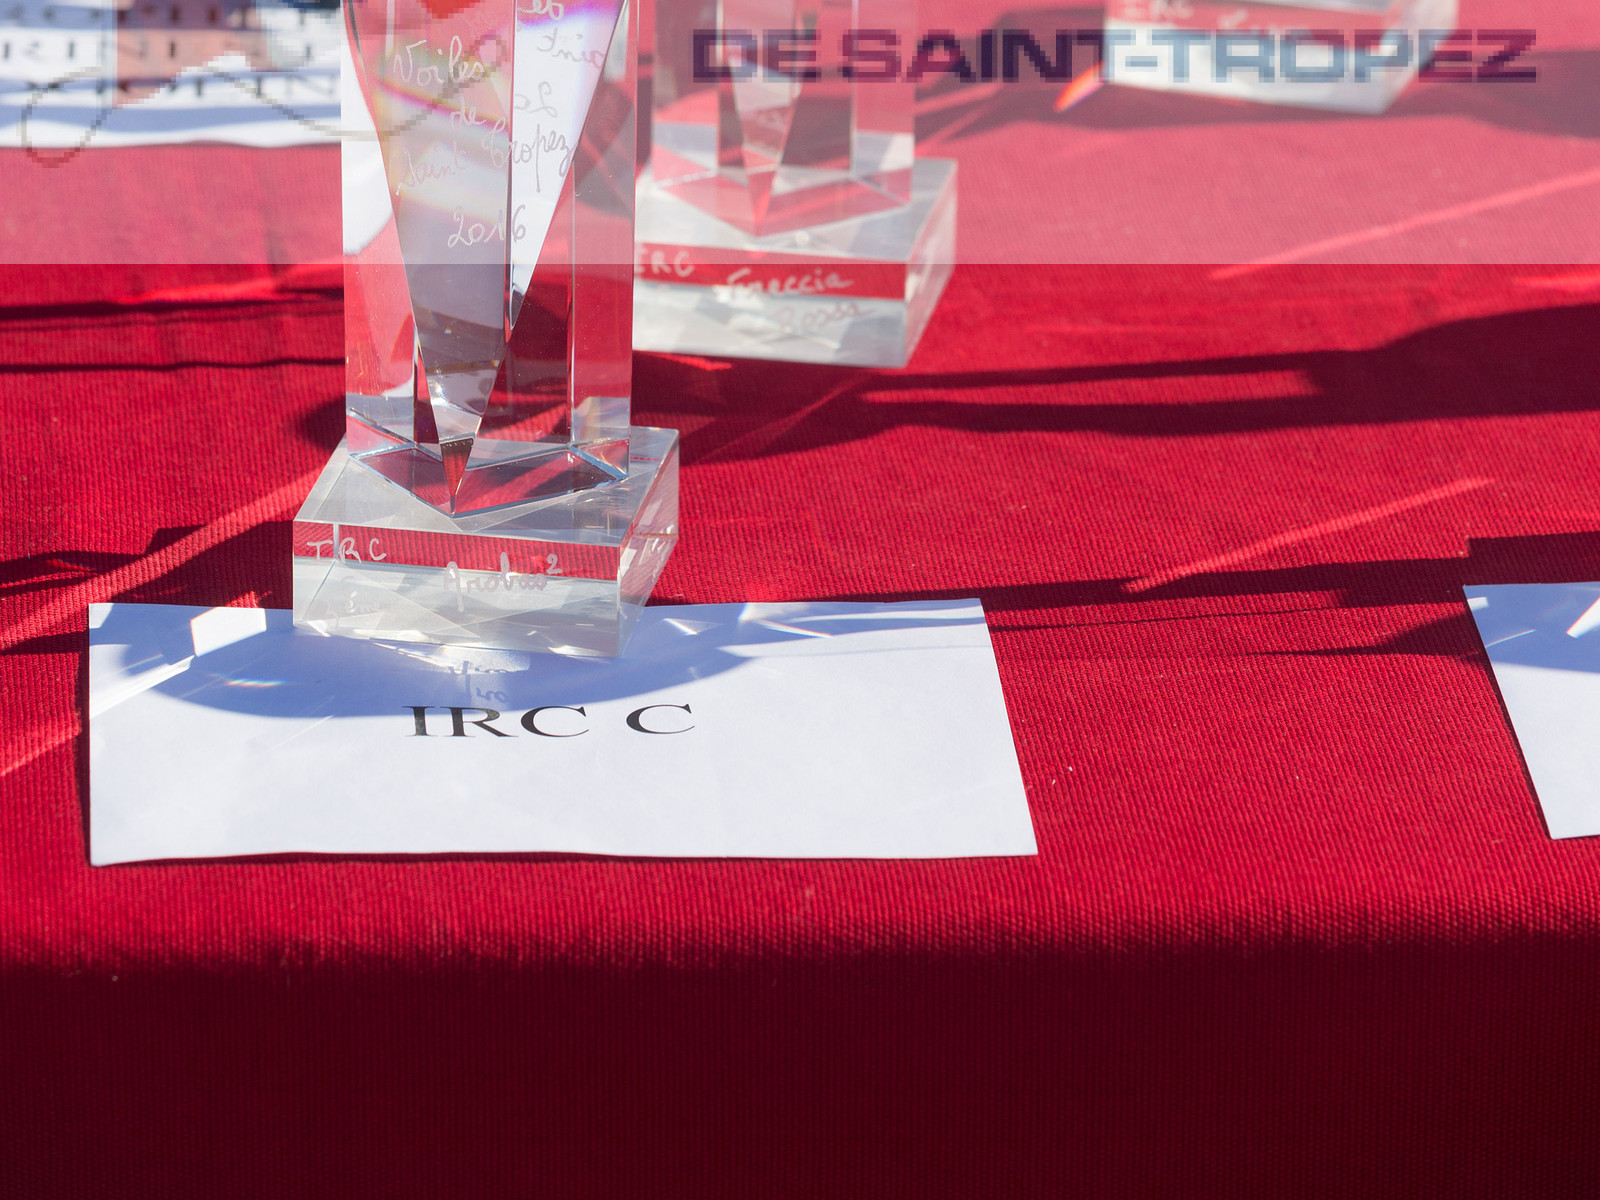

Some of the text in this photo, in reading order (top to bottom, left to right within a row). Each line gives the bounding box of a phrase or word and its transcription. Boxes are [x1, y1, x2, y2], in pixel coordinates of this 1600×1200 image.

[393, 35, 484, 86] Voiles
[451, 96, 487, 131] de
[394, 118, 579, 197] Saint Tropez
[447, 204, 527, 248] 2016
[402, 703, 696, 738] IRC C
